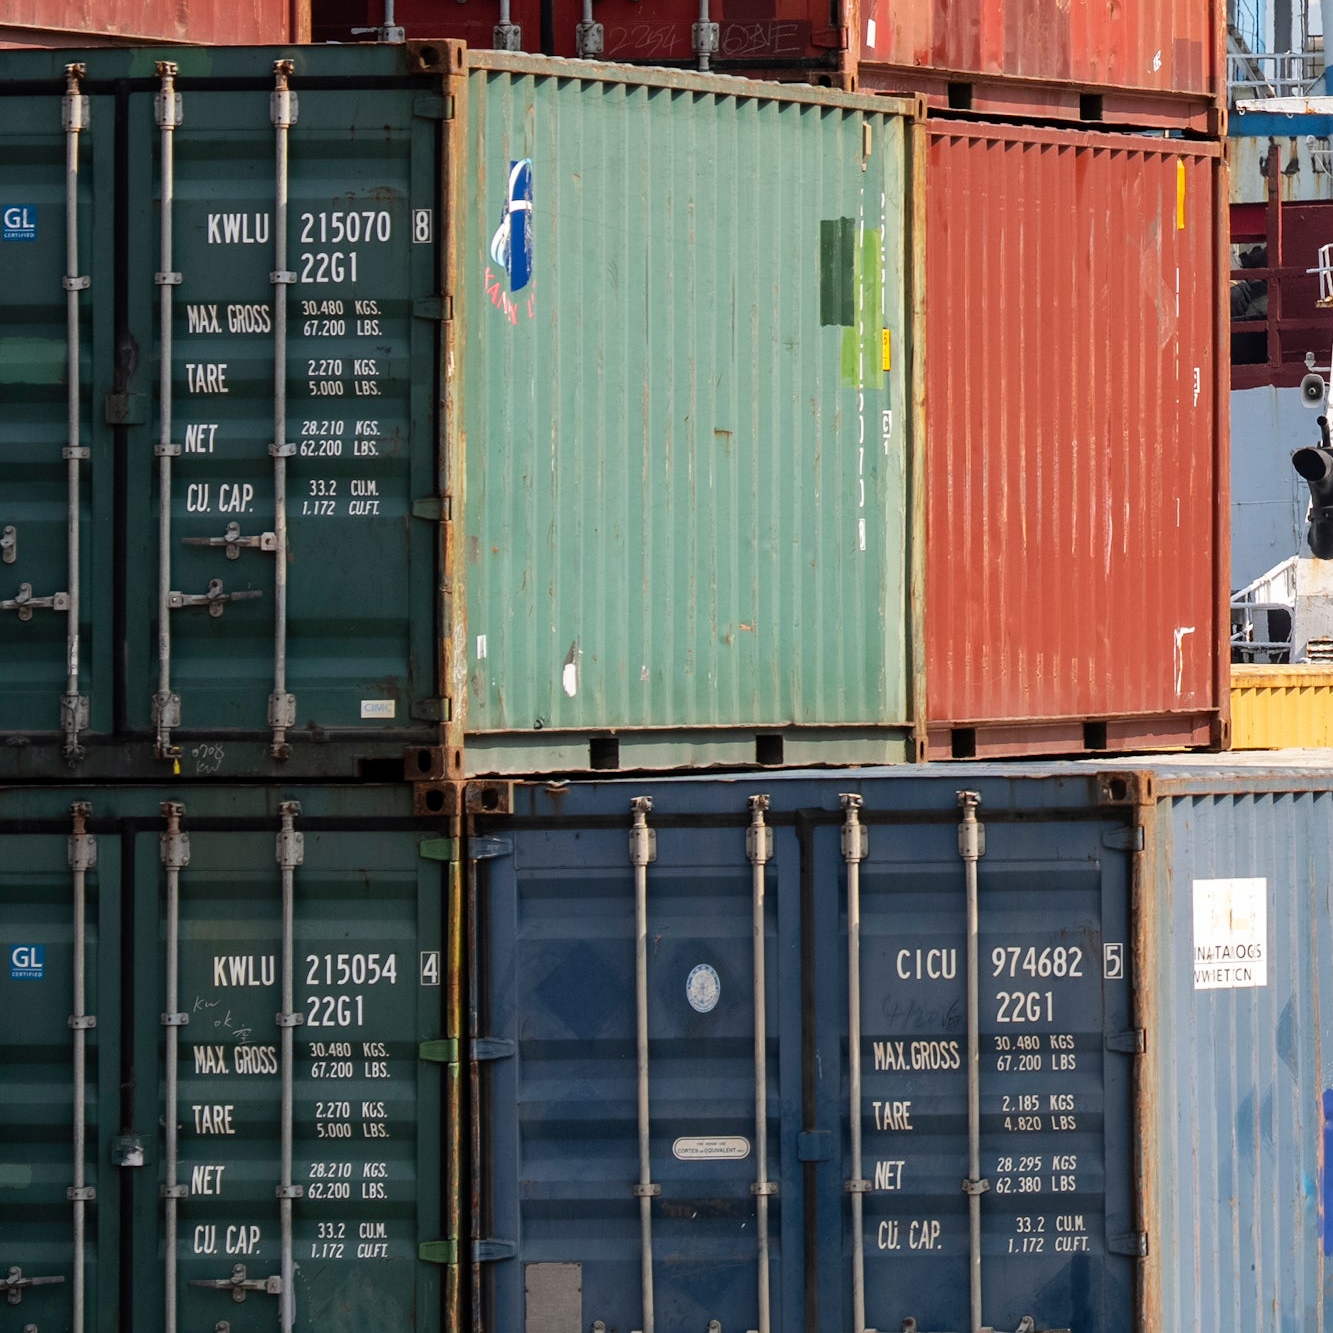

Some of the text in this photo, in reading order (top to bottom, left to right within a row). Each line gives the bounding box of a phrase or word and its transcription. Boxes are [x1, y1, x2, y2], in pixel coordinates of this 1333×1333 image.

[4, 208, 34, 228] GL
[208, 210, 431, 244] KWLU 215070 8
[302, 252, 356, 282] 22G1
[355, 301, 381, 314] KGS.
[187, 305, 272, 333] MAX. GROSS
[358, 320, 382, 335] LBS.
[355, 360, 379, 375] KGS.
[186, 364, 228, 392] TARE
[355, 381, 381, 395] LBS.
[355, 421, 380, 435] KGS.
[186, 425, 218, 452] NET
[354, 441, 378, 455] LBS.
[310, 480, 336, 495] 33.2
[187, 484, 253, 512] CU. CAP.
[12, 948, 42, 967] GL
[897, 943, 1123, 979] CICU 974682 5
[214, 952, 439, 986] KWLU 215054 4
[307, 996, 362, 1026] 22G1
[997, 992, 1052, 1022] 22G1
[363, 1043, 389, 1056] KGS.
[1050, 1035, 1074, 1048] KGS
[194, 1046, 277, 1074] MAX. GROSS
[365, 1062, 390, 1077] LBS.
[1053, 1055, 1075, 1069] LBS
[1050, 1095, 1074, 1110] KGS
[193, 1105, 234, 1133] TARE
[873, 1102, 912, 1129] TARE
[1052, 1116, 1076, 1129] LBS
[363, 1163, 387, 1177] KGS.
[1053, 1156, 1076, 1170] KGS
[192, 1166, 224, 1195] NET
[876, 1162, 905, 1190] NET
[1052, 1176, 1075, 1191] LBS
[363, 1183, 387, 1198] LBS.
[1017, 1217, 1044, 1232] 33.2
[194, 1226, 259, 1254] CU. CAP.
[910, 1221, 941, 1249] CAP.
